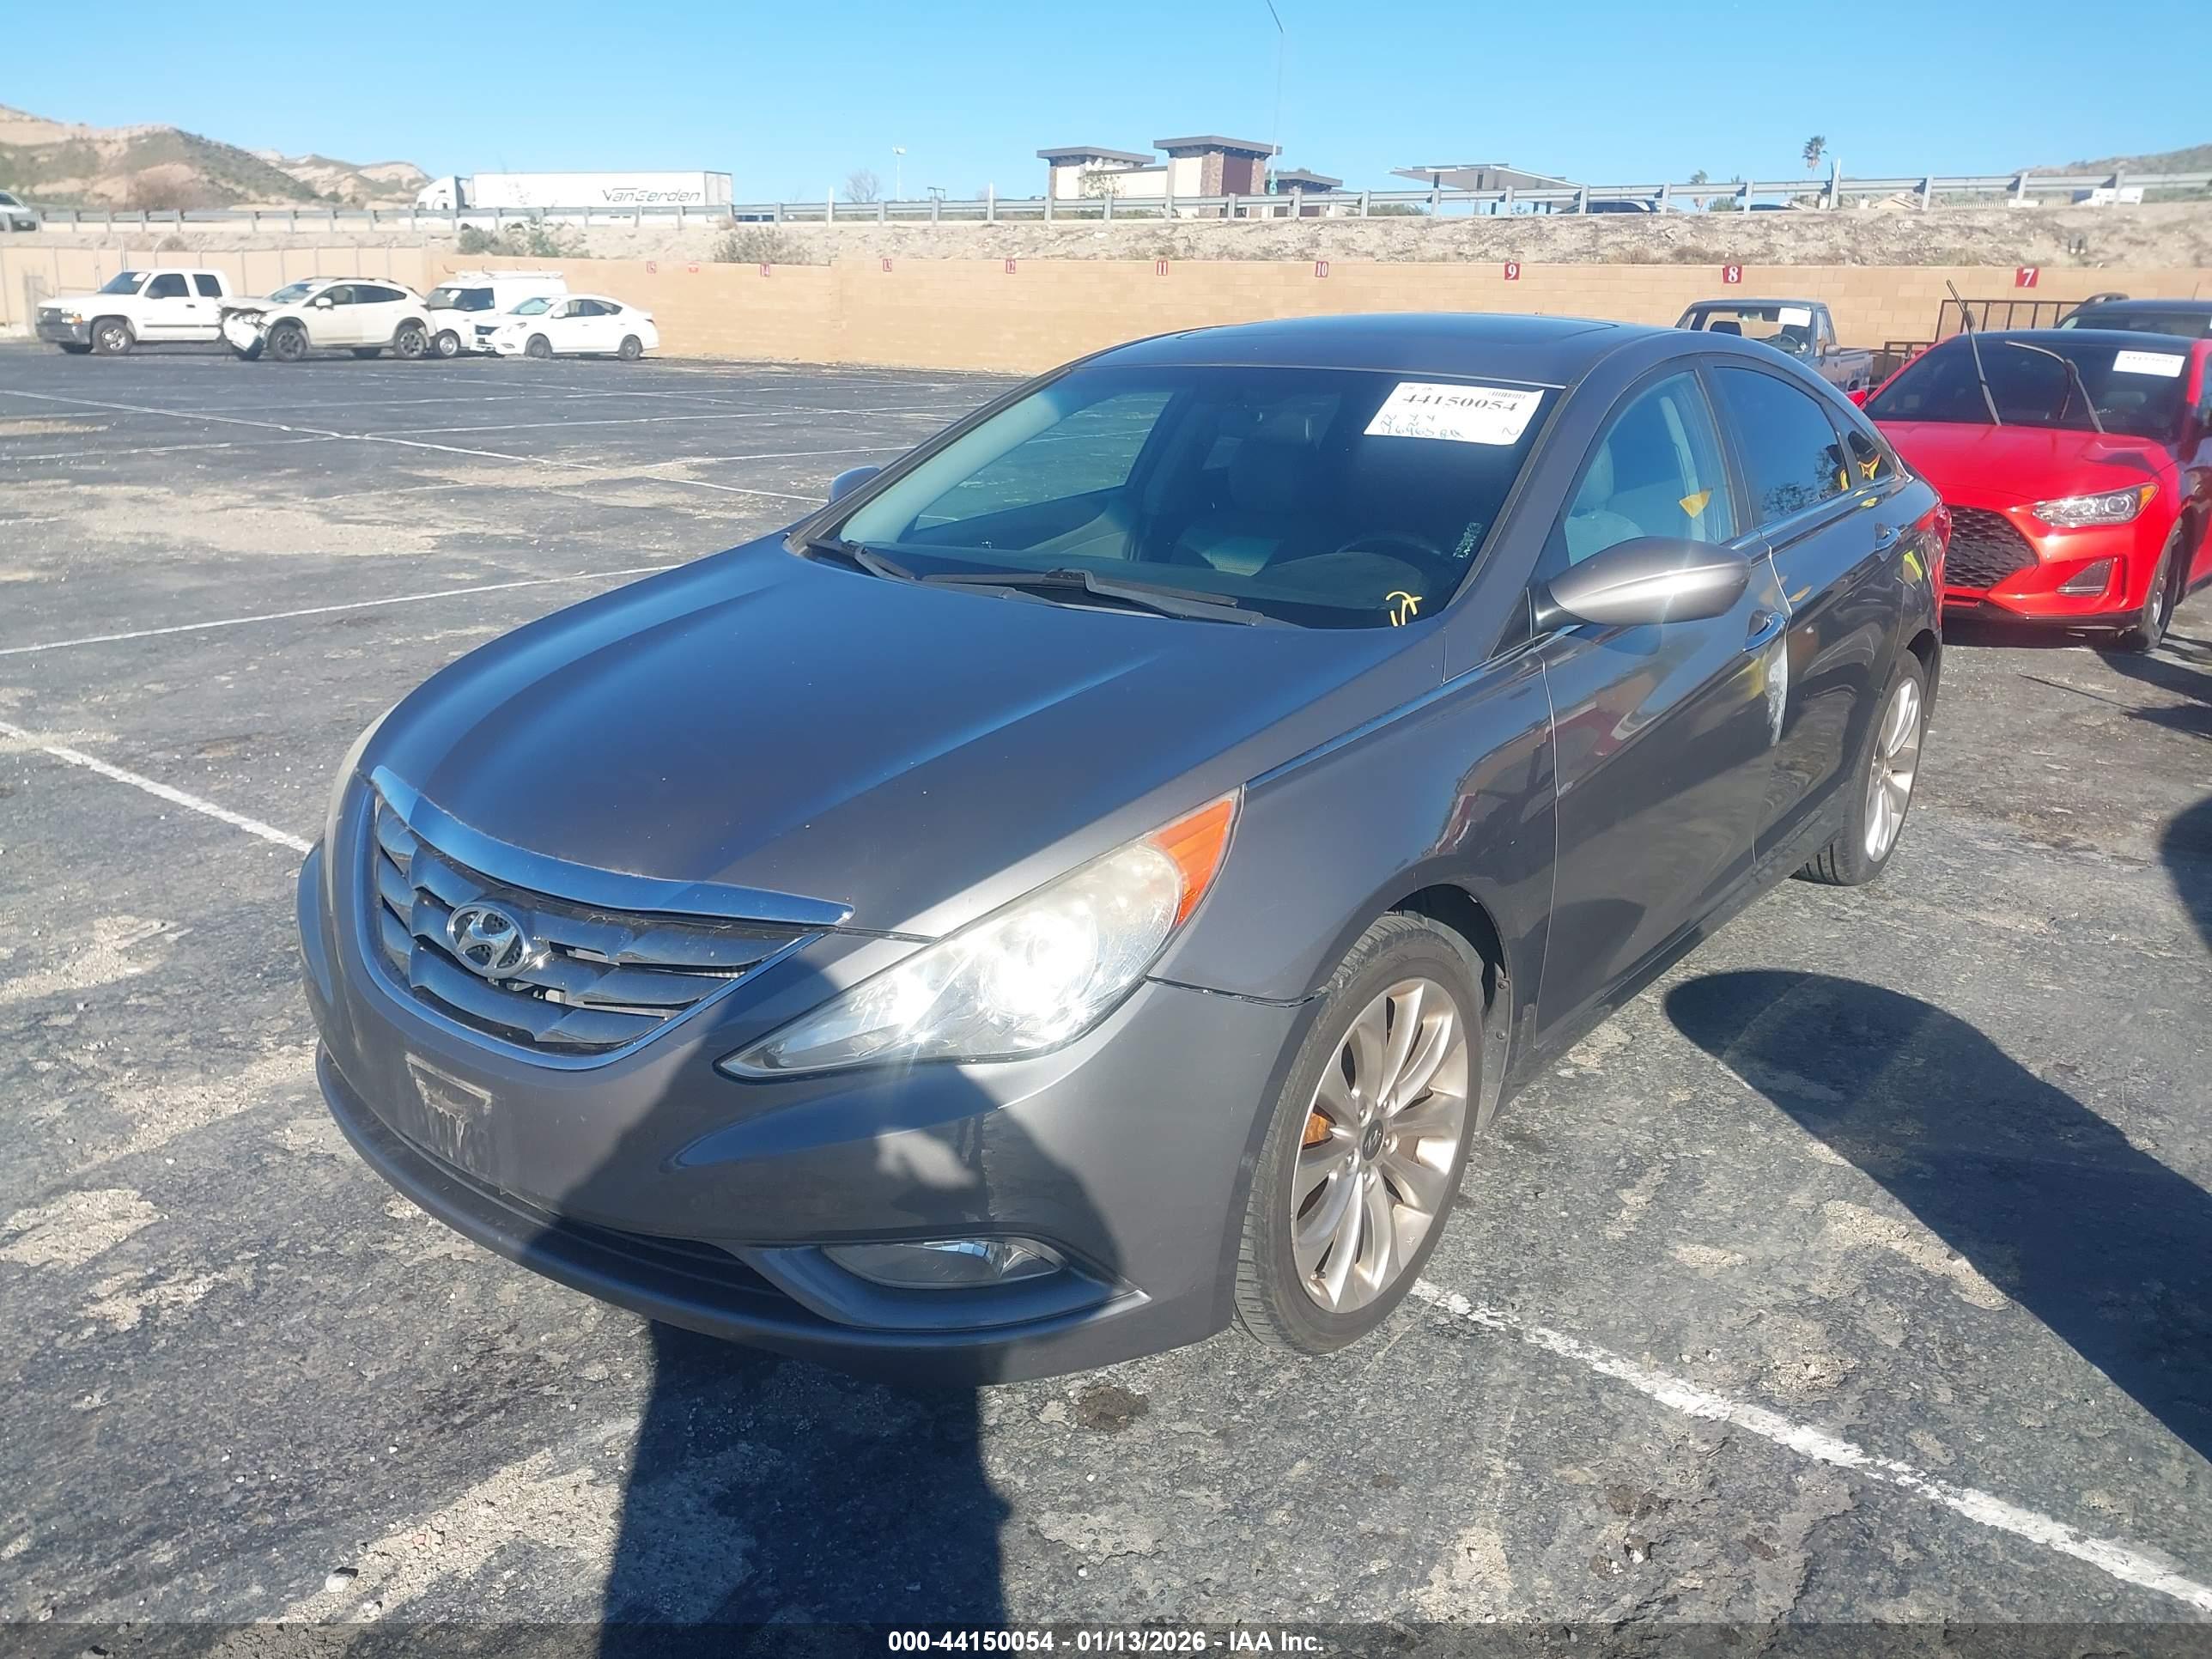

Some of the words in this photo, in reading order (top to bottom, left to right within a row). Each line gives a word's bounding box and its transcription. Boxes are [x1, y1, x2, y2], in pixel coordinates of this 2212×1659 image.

[1158, 261, 1167, 275] 11
[1317, 262, 1328, 276] 10
[1507, 264, 1517, 279] 9
[1728, 266, 1739, 283] 8
[2022, 268, 2036, 287] 7
[1402, 393, 1519, 411] 44150054
